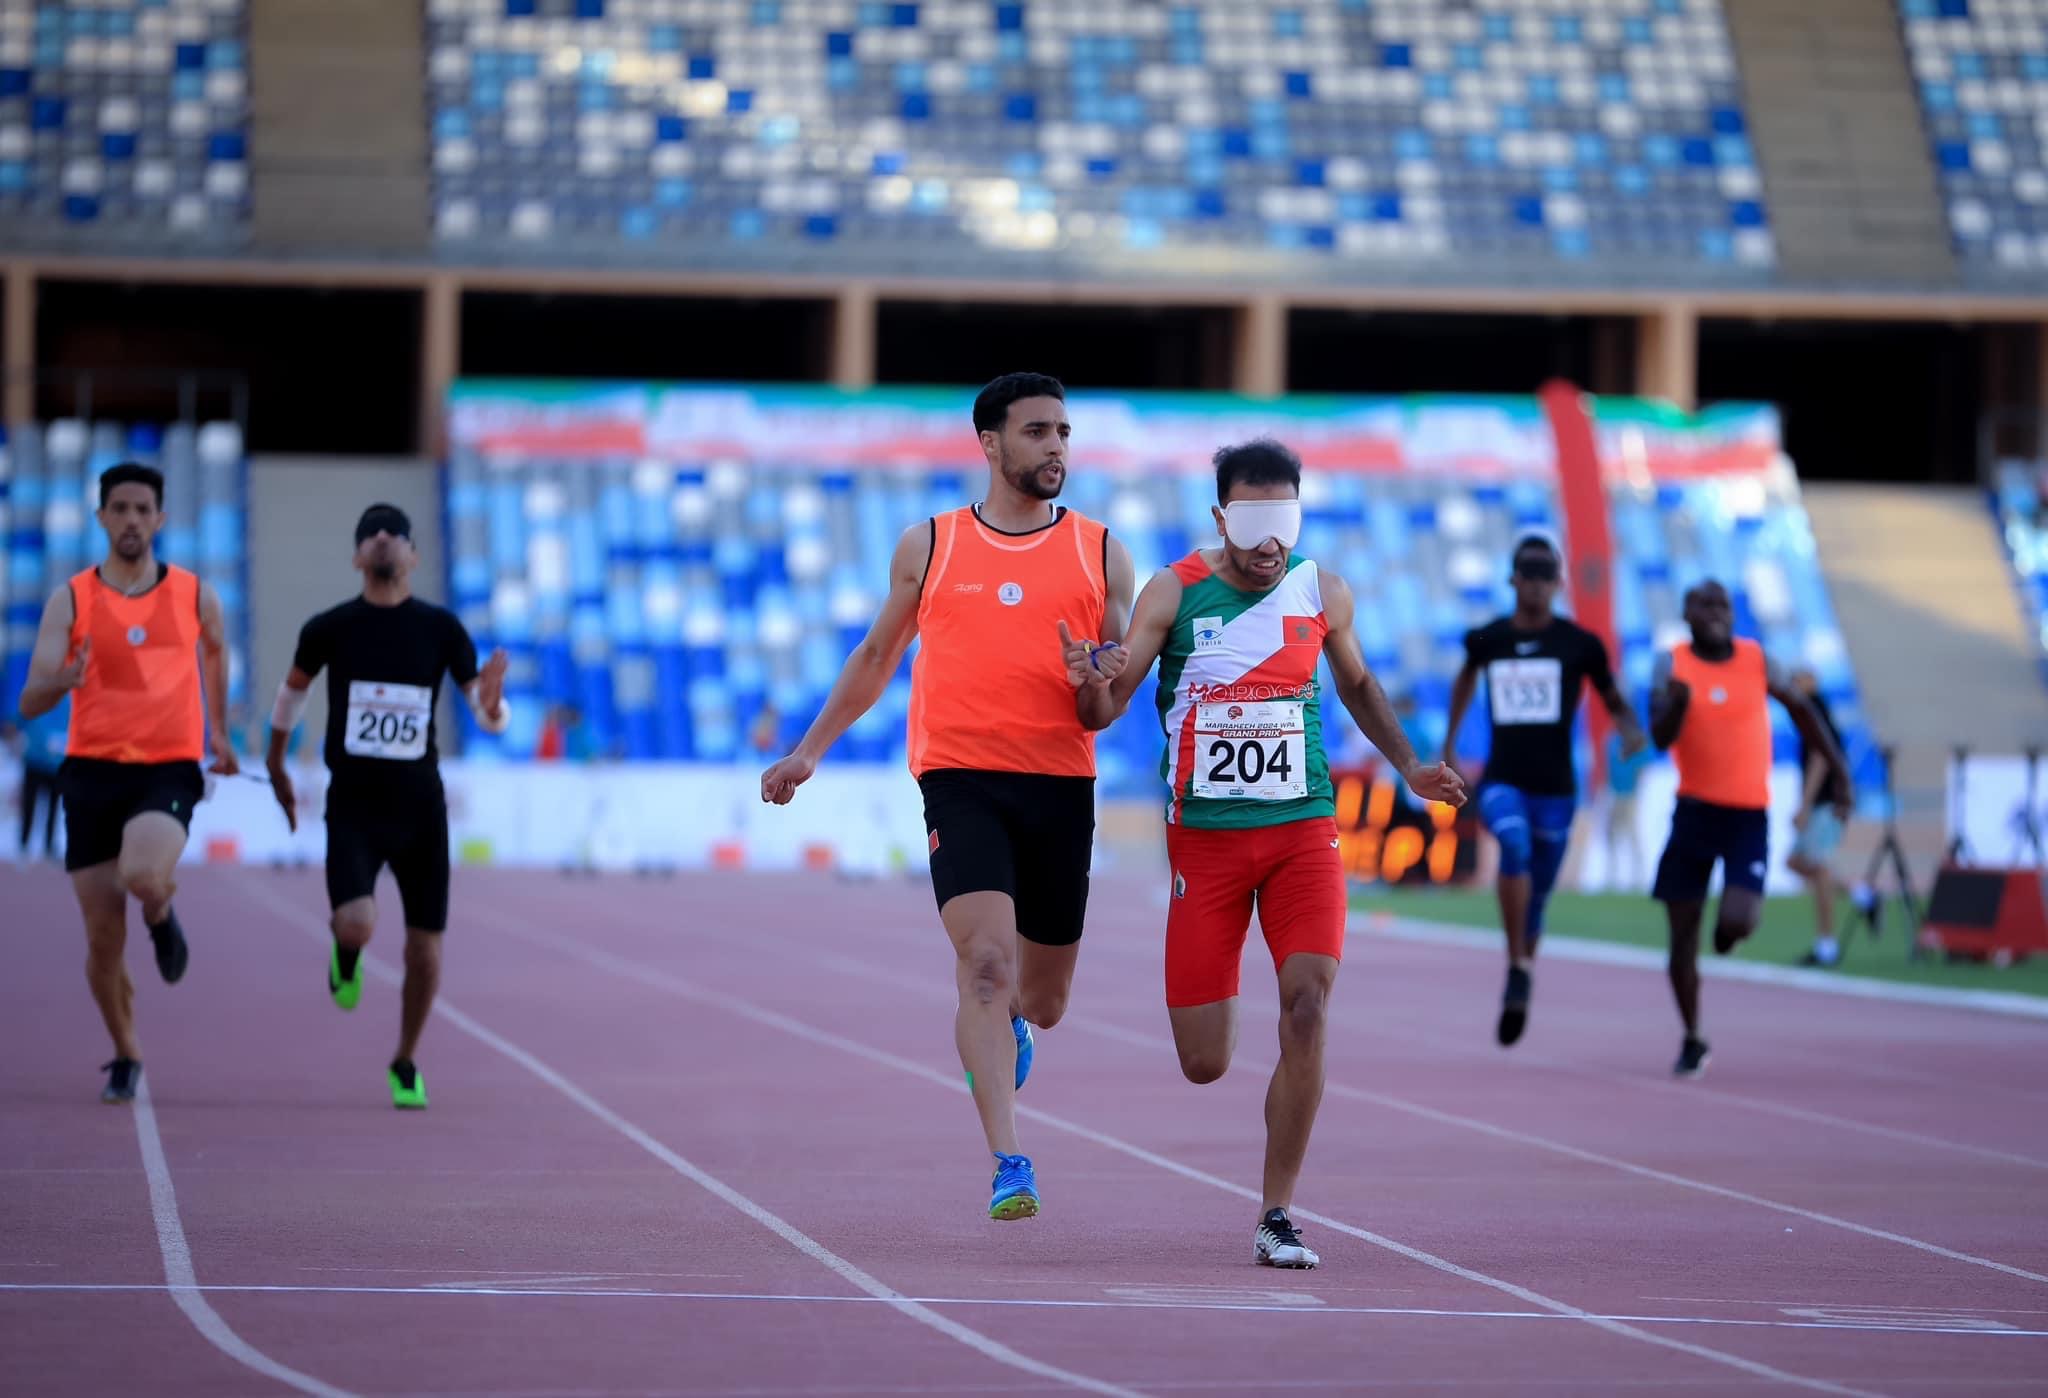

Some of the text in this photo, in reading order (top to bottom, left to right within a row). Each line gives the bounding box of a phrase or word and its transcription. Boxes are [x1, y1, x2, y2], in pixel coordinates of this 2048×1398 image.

[358, 711, 418, 744] 205
[1204, 722, 1256, 730] MARRAKECH
[1222, 729, 1281, 738] GRAND PRIX
[1208, 739, 1292, 784] 204
